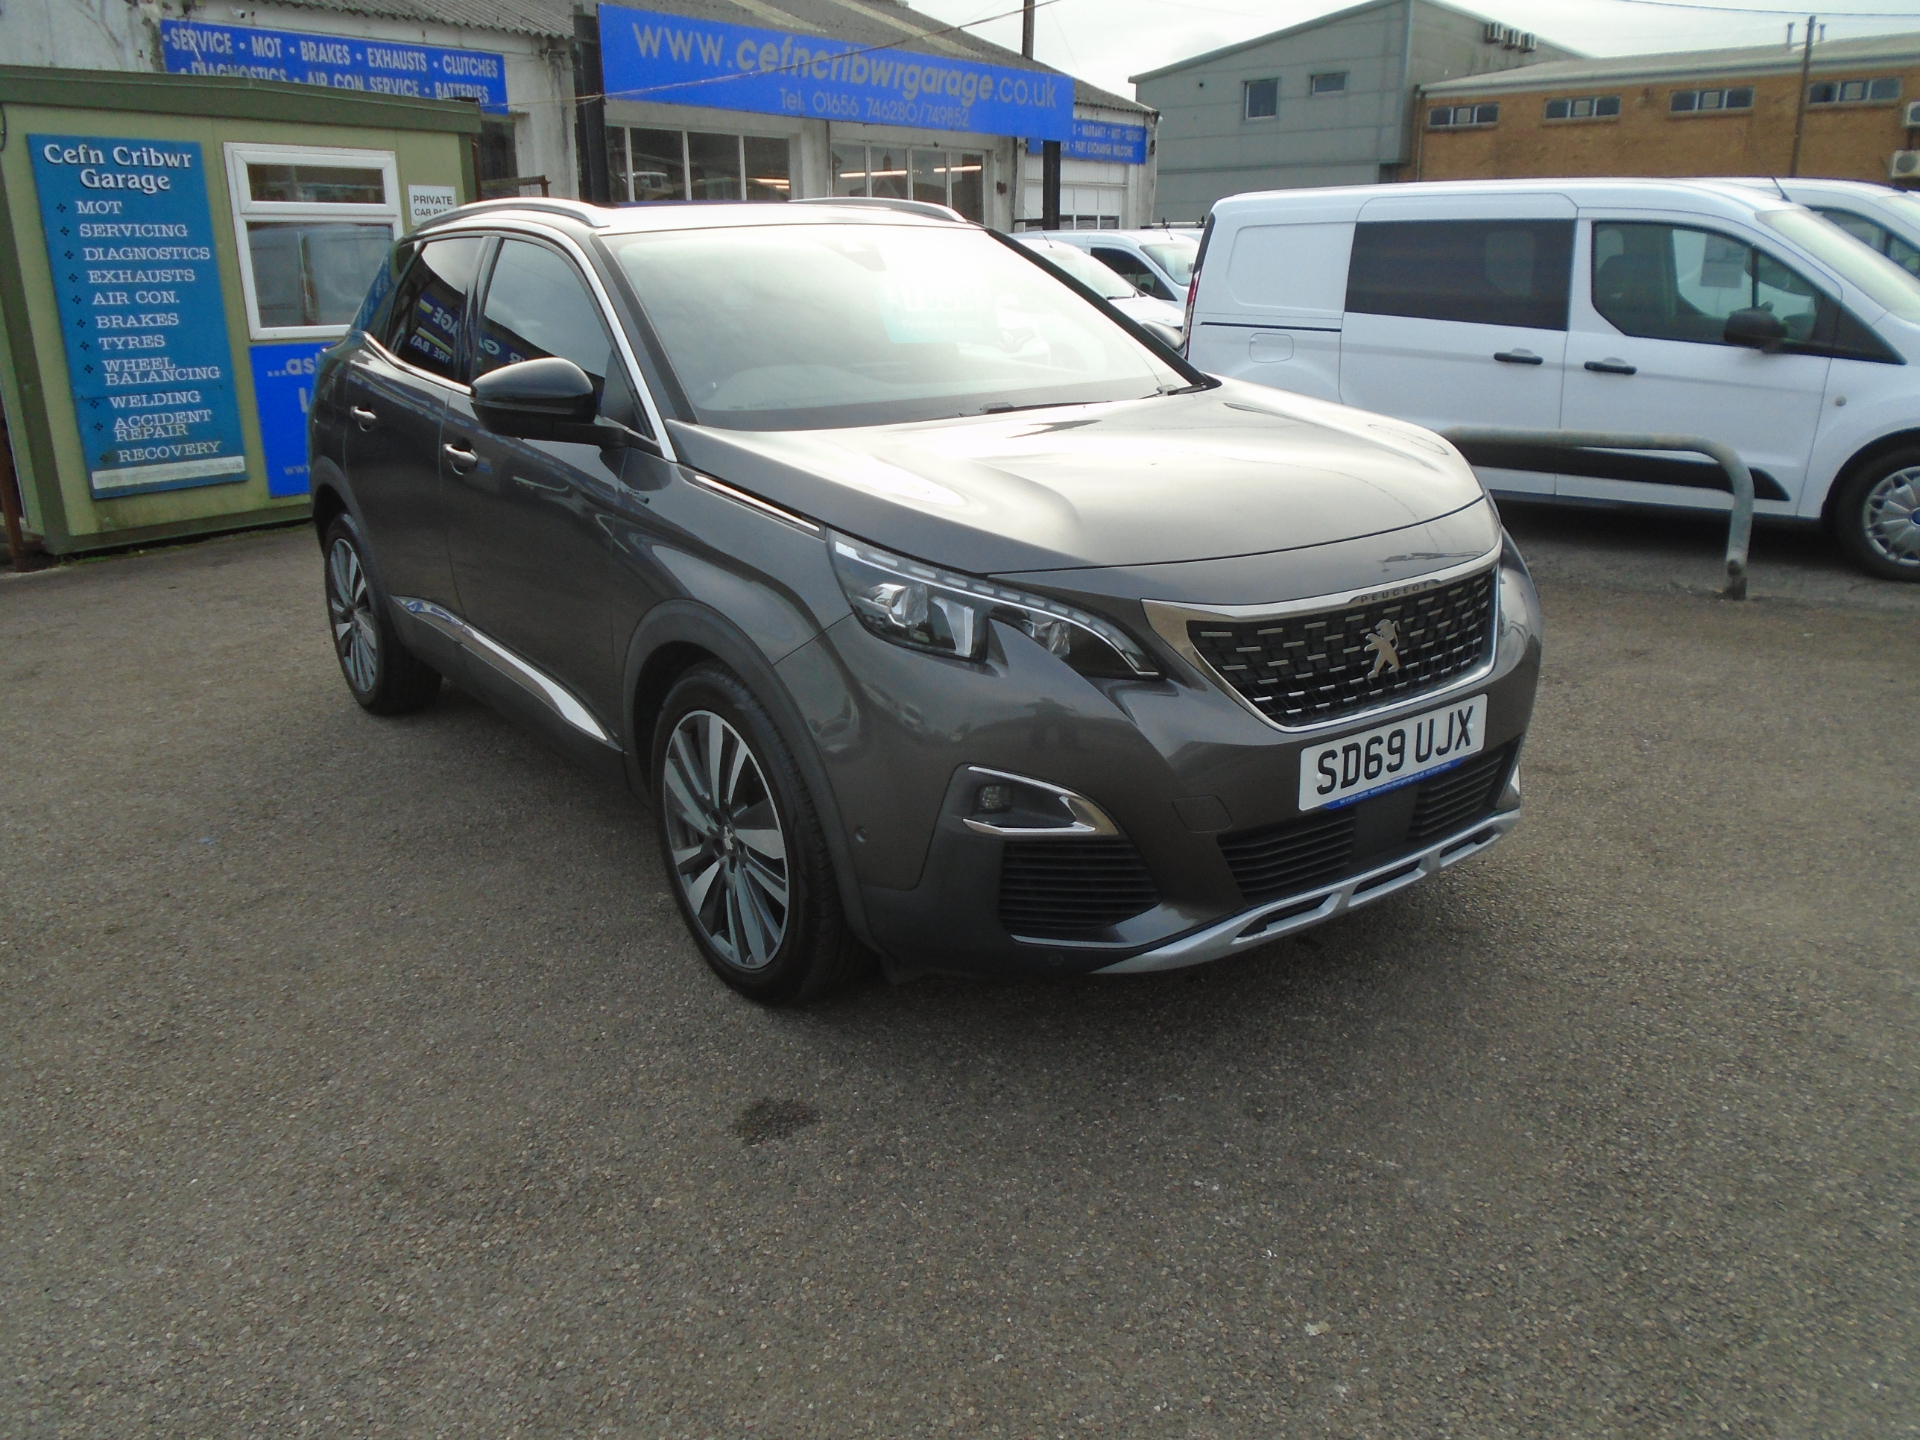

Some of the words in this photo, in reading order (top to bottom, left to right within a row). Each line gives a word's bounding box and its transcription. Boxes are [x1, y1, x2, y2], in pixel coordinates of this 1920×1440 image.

[170, 27, 233, 55] SERVICE
[251, 35, 282, 59] MOT
[300, 40, 351, 66] BRAKES
[367, 47, 428, 73] EXHAUSTS
[442, 55, 499, 79] CLUTCHES
[632, 22, 1057, 108] www.cefncribwrgarage.co.uk
[812, 91, 859, 116] 01656
[43, 143, 105, 165] Cefn
[112, 146, 192, 169] Cribwr
[80, 168, 171, 195] Garage
[75, 201, 122, 215] MOT
[413, 195, 453, 205] PRIVATE
[414, 208, 432, 217] CAR
[79, 223, 188, 238] SERVICING
[83, 246, 211, 261] DIAGNOSTICS
[87, 269, 196, 284] EXHAUSTS
[92, 291, 130, 306] AIR
[135, 290, 180, 305] CON.
[95, 312, 180, 329] BRAKES
[98, 334, 166, 351] TYRES
[102, 356, 176, 373] WHEEL
[104, 365, 221, 387] BALANCING
[109, 389, 202, 409] WELDING
[114, 408, 212, 430] ACCIDENT
[114, 423, 189, 442] REPAIR
[117, 440, 221, 463] RECOVERY
[1360, 581, 1428, 603] PEUGEOT
[1316, 728, 1407, 796] SD69
[1415, 704, 1474, 764] UJX
